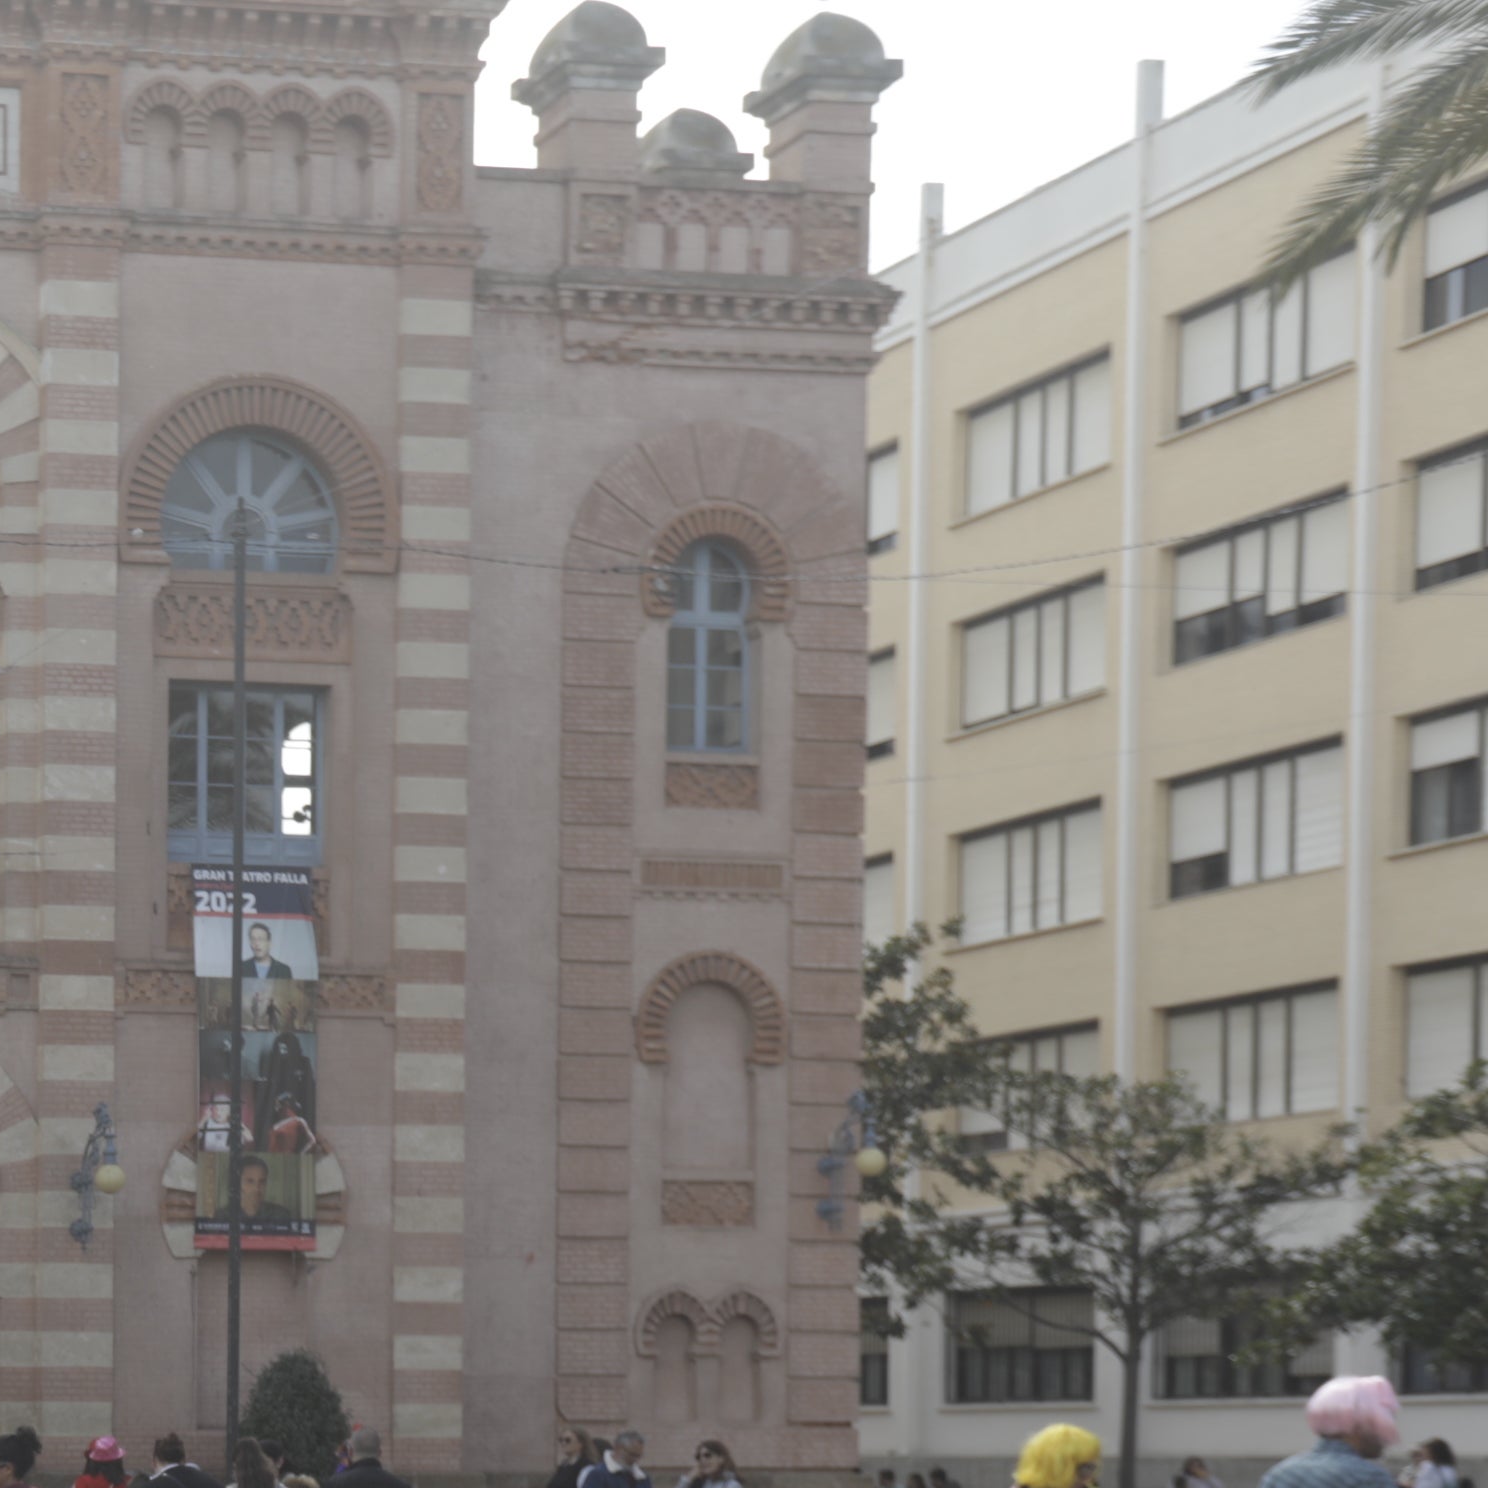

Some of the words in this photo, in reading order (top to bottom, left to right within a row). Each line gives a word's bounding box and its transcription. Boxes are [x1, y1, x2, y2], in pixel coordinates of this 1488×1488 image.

[193, 869, 225, 880] GRAN
[226, 870, 272, 883] TATRO
[274, 872, 308, 884] FALLA
